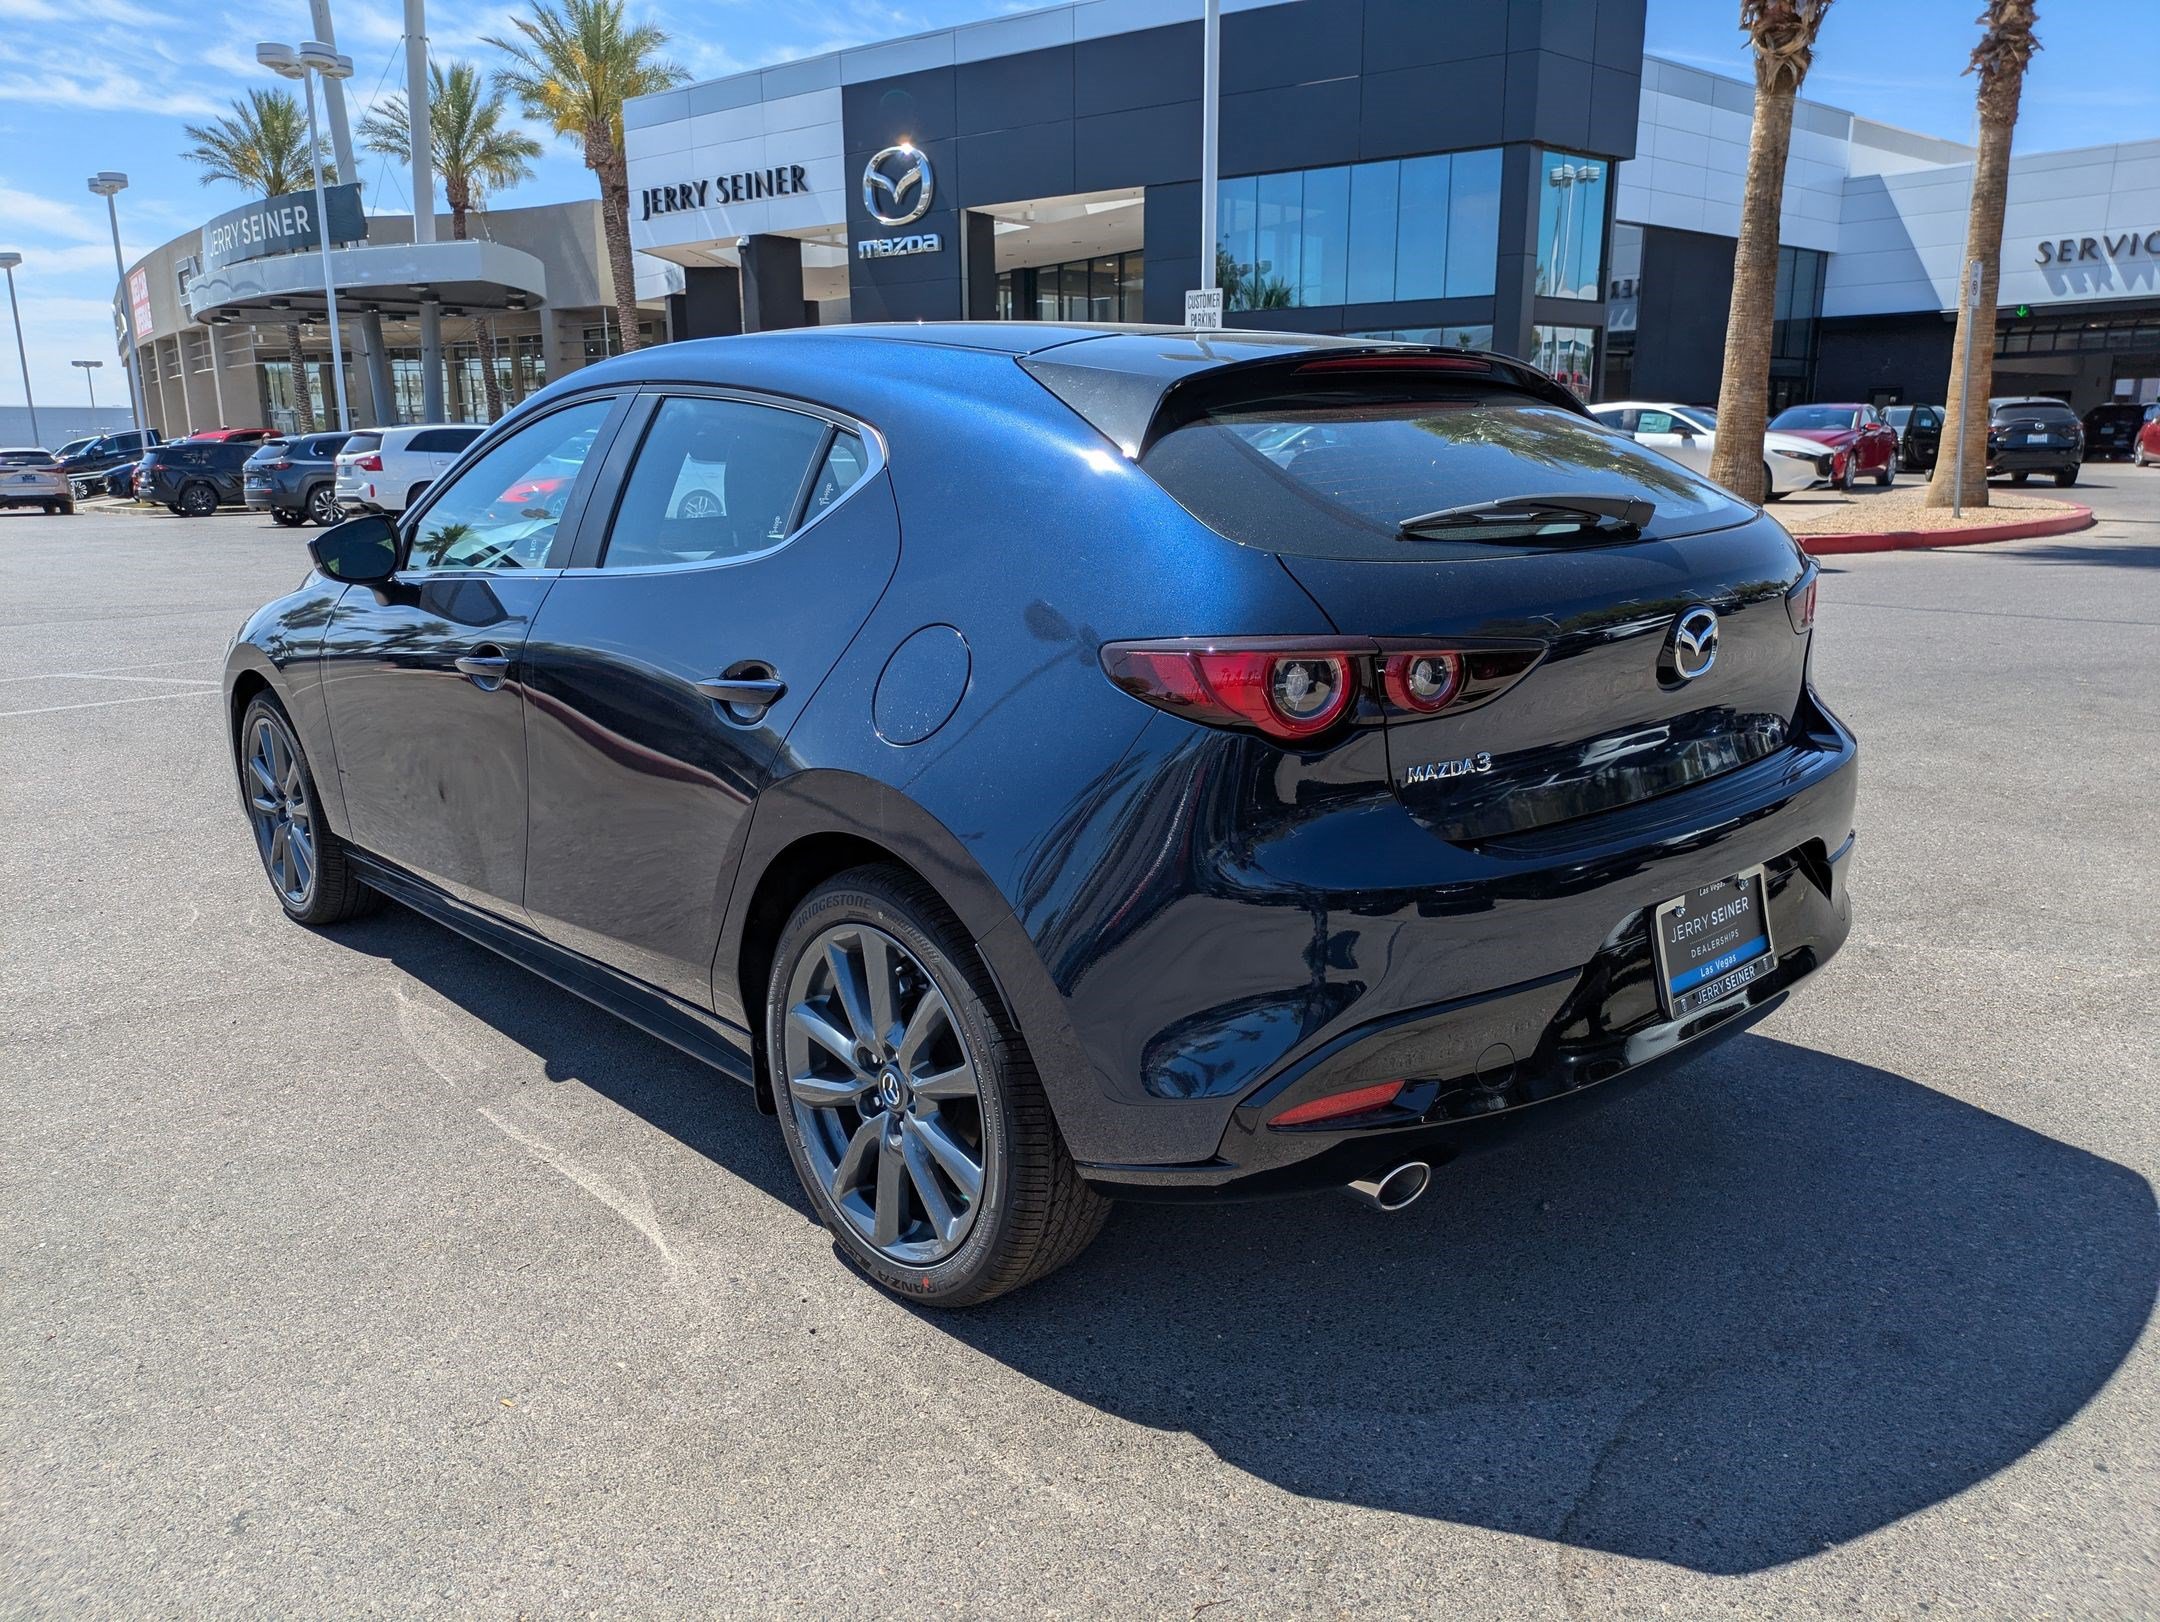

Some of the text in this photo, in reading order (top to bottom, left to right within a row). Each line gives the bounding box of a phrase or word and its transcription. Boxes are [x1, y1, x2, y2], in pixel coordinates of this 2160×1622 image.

[642, 165, 808, 221] JERRY SEINER
[209, 206, 311, 257] JERRY SEINER
[1188, 293, 1220, 309] CUSTOMER
[1191, 312, 1216, 328] PARKING
[1699, 886, 1709, 896] Las
[795, 894, 872, 931] BRIDGESTONE
[1671, 896, 1749, 943] JERRY SEINER
[1691, 929, 1739, 958] DEALERSHIPS
[1700, 953, 1737, 978] Las Vegas
[1697, 966, 1756, 1005] JERRY SEINER
